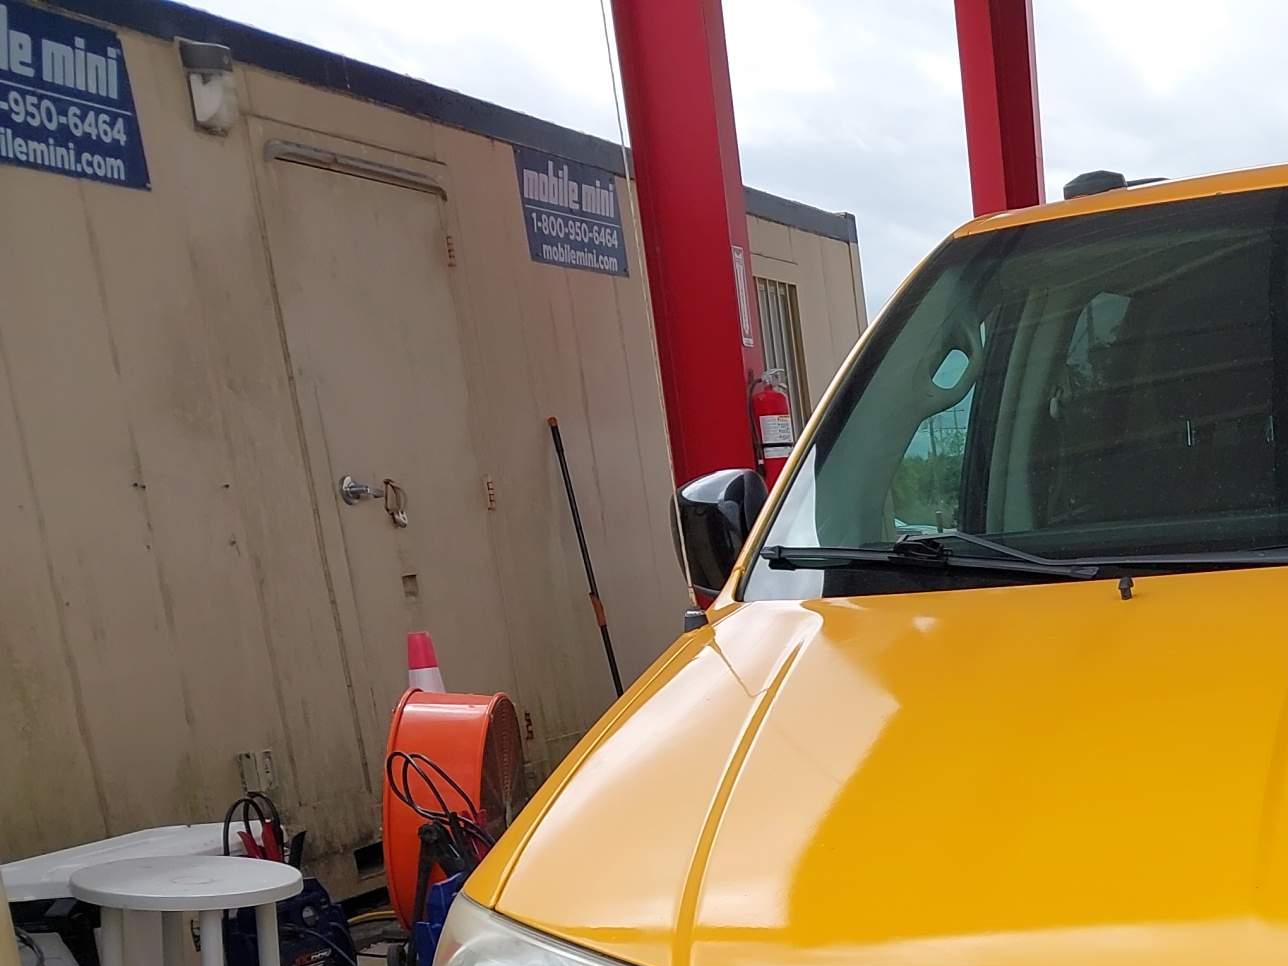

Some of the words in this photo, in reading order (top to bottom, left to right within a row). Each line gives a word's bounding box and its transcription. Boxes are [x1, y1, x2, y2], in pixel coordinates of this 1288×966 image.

[41, 36, 118, 99] mini
[523, 160, 579, 210] mobile
[582, 180, 614, 218] mini
[531, 212, 618, 248] 1-800-950-6464
[542, 243, 618, 272] mobilemini.com
